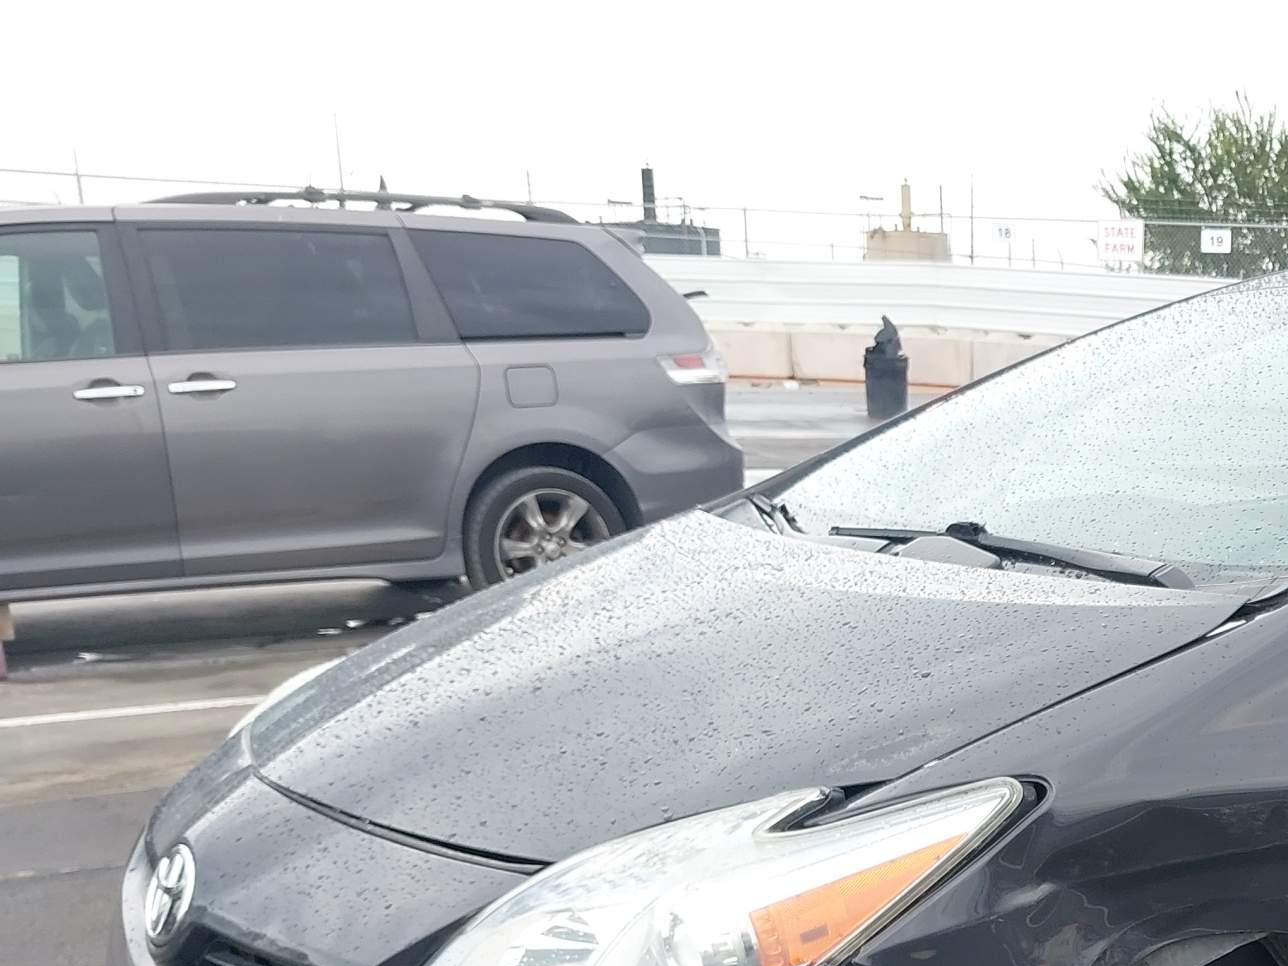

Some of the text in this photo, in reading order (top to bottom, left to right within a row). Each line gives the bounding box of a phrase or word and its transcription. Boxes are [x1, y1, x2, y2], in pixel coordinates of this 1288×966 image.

[1103, 226, 1137, 239] STATE
[1210, 235, 1224, 247] 19
[1104, 242, 1136, 255] FARM
